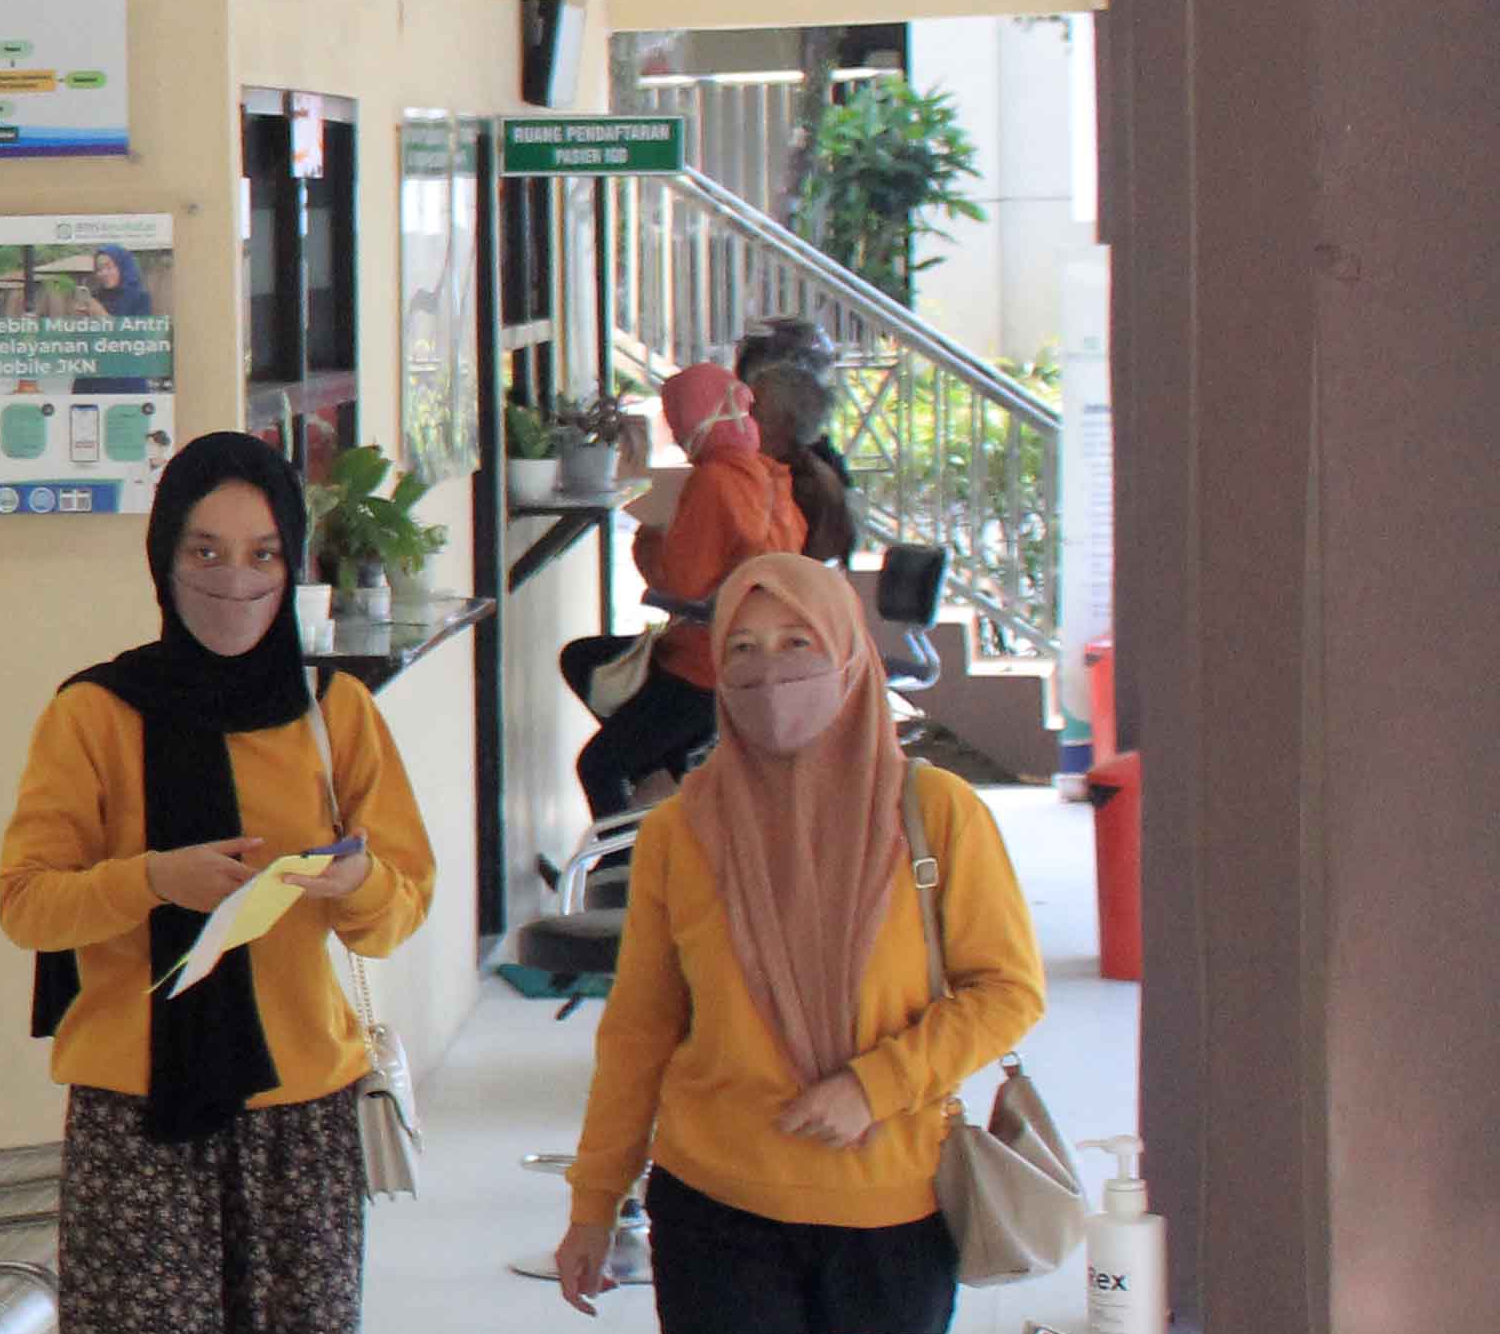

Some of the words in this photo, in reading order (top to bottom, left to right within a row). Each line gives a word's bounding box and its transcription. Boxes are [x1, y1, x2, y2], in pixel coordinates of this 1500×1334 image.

[513, 125, 563, 144] RUANG
[566, 123, 670, 143] PENDAFTARAN
[45, 316, 114, 333] Mudah
[119, 315, 171, 332] Antri
[94, 337, 172, 356] dengan
[57, 358, 98, 374] JKN
